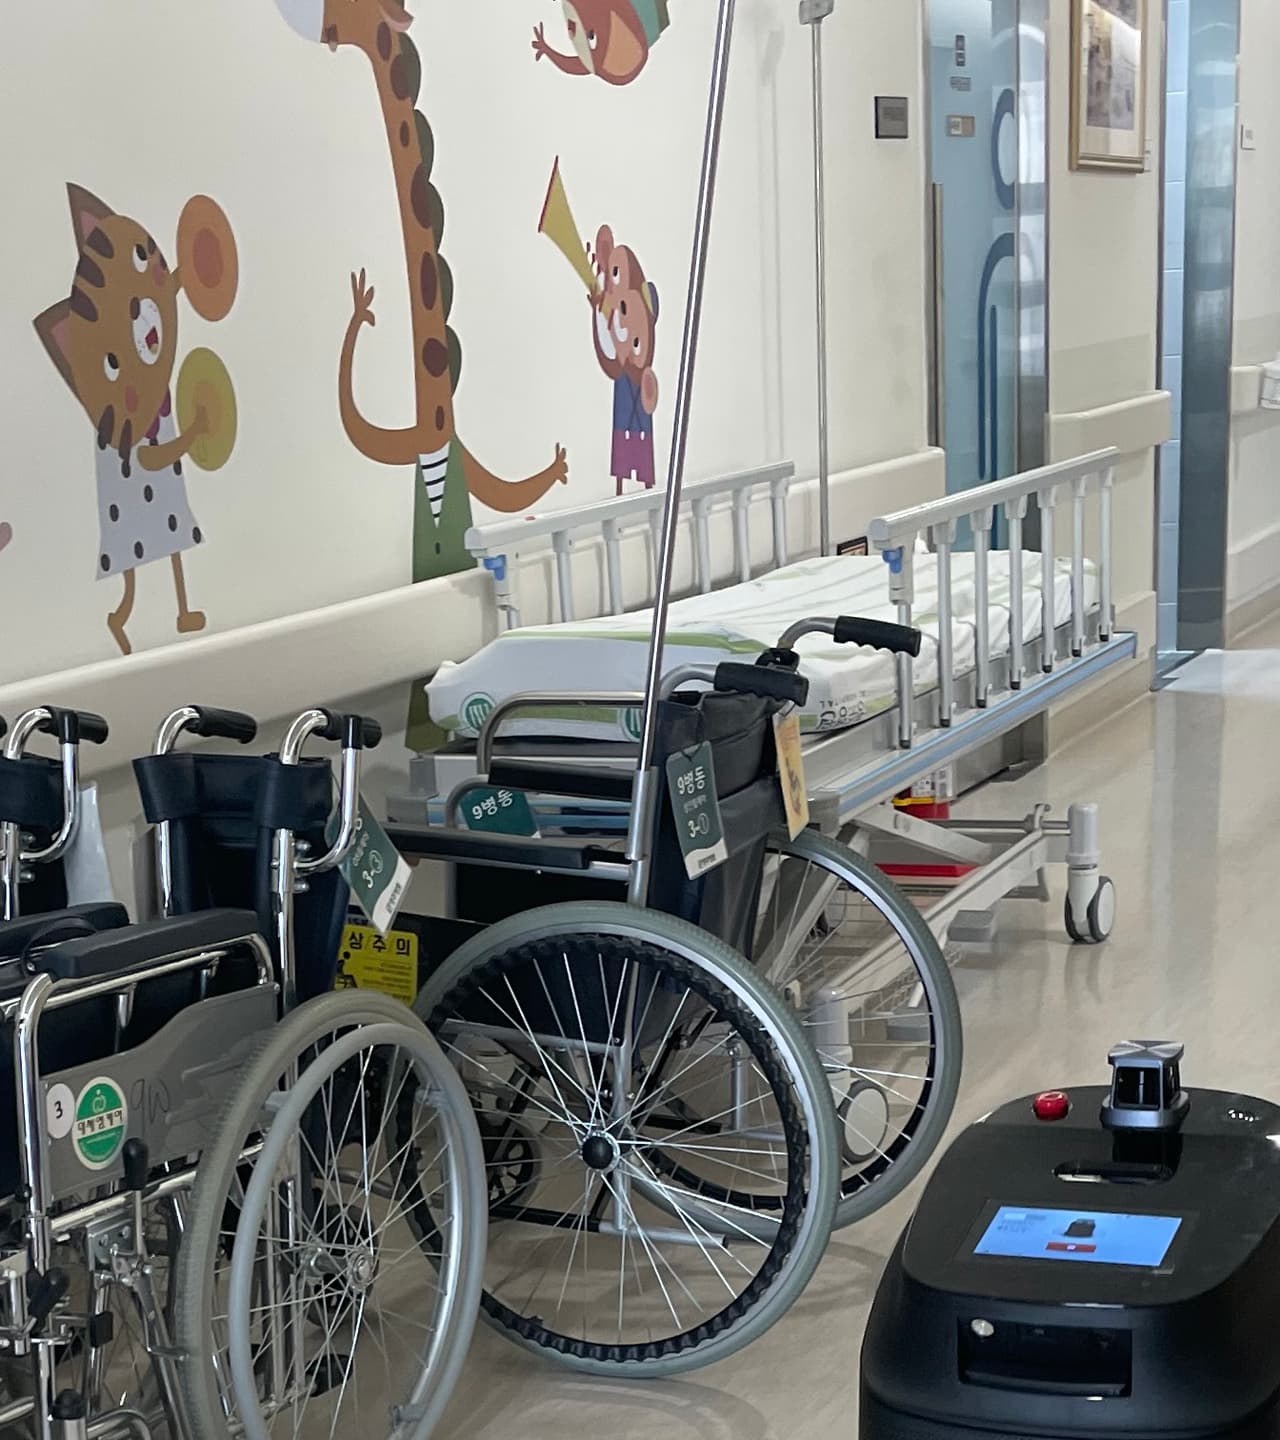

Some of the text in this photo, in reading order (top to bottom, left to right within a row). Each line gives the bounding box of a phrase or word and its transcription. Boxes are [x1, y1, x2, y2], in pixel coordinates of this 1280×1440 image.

[676, 765, 707, 795] 9병동
[471, 789, 513, 820] 9병동
[53, 1100, 64, 1119] 3
